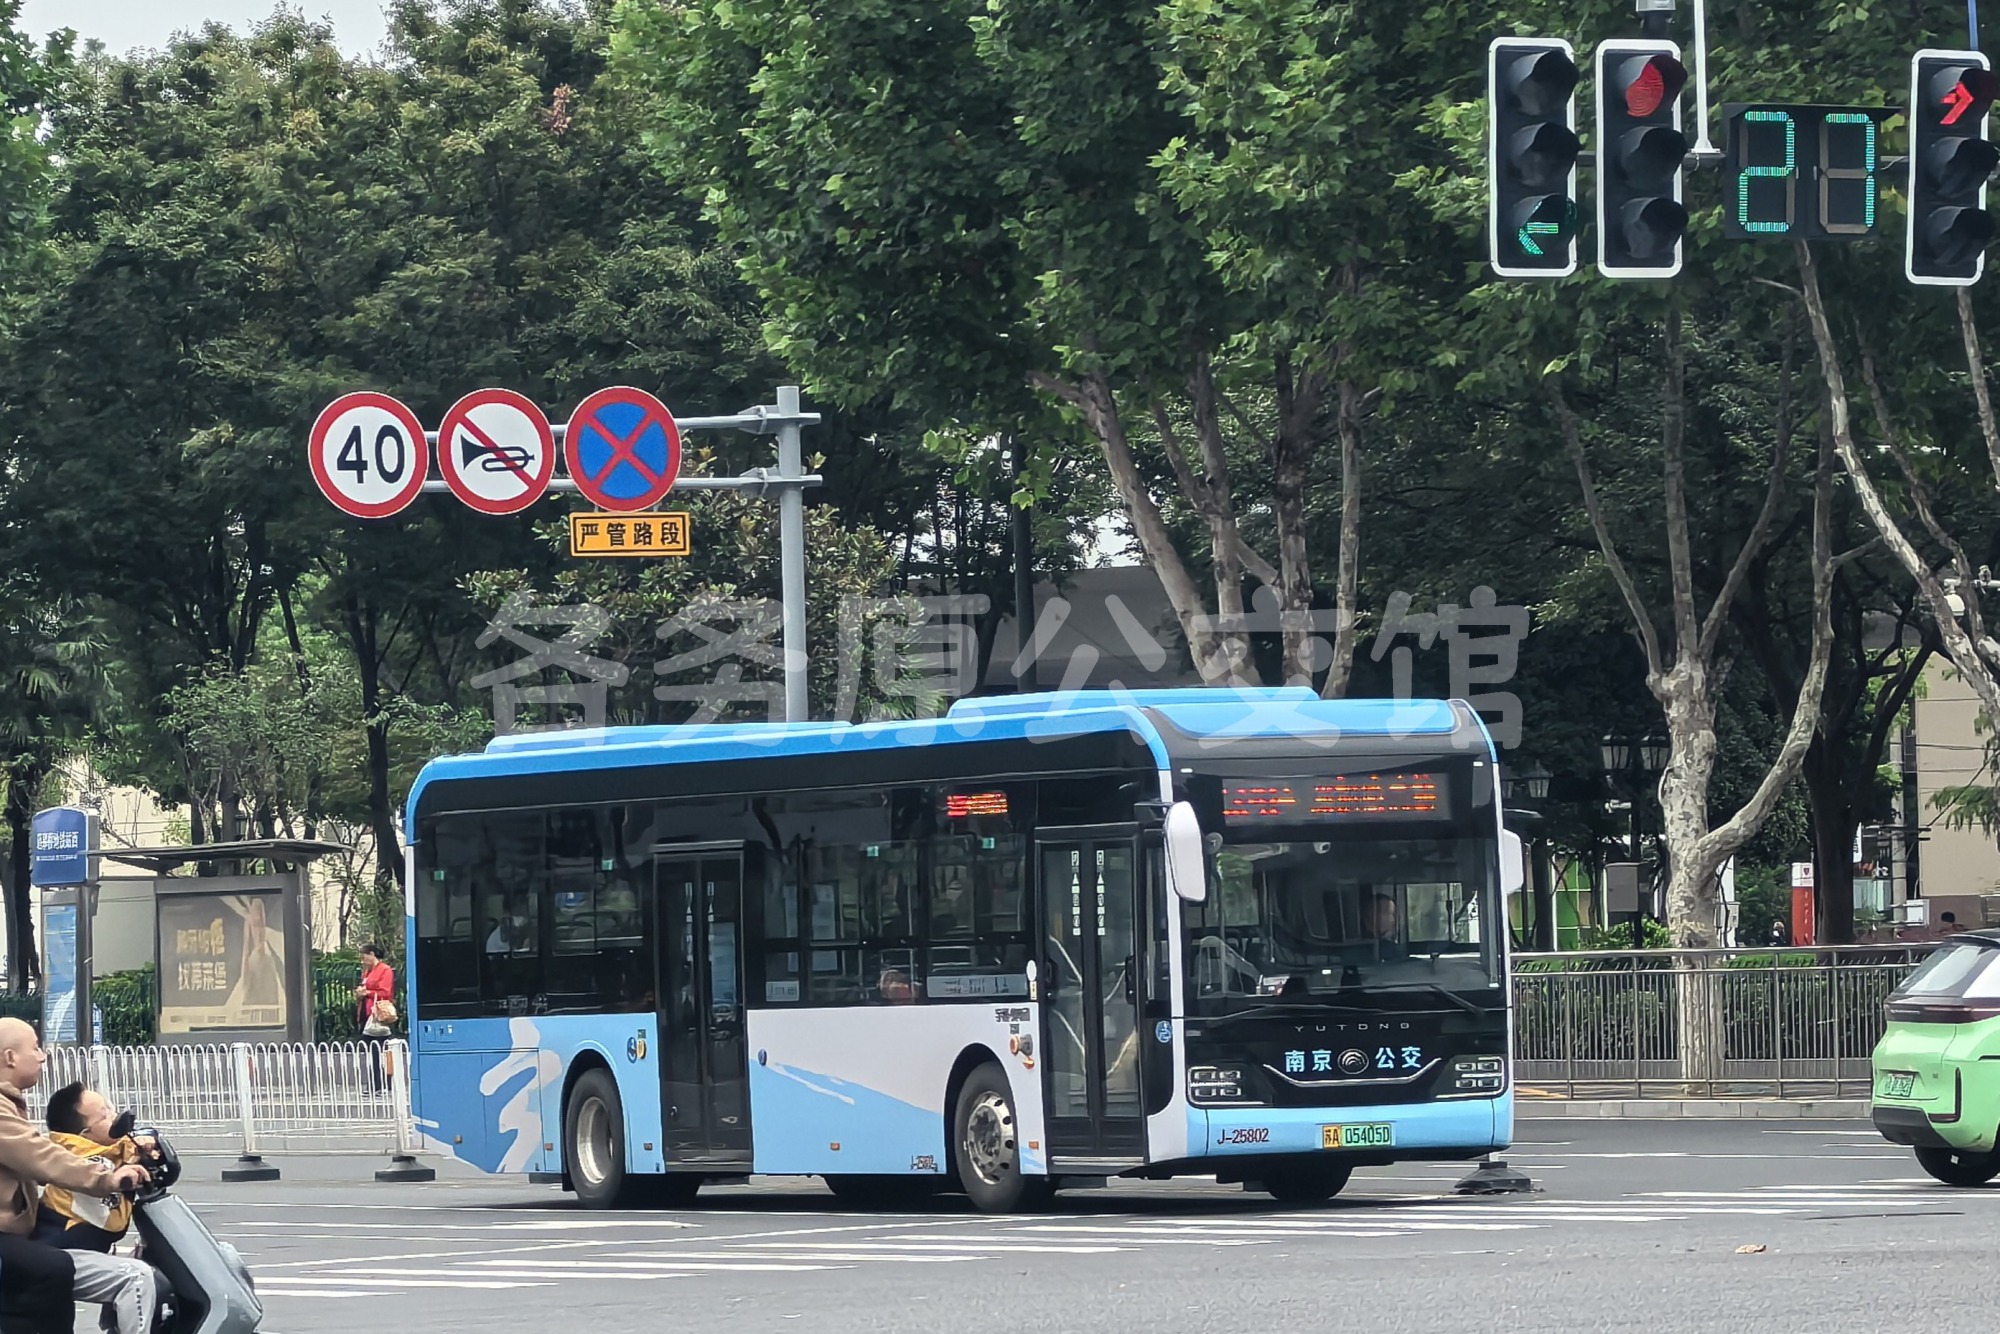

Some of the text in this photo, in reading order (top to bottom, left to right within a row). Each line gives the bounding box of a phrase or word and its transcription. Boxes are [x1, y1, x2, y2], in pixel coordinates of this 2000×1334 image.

[1738, 110, 1876, 233] 27
[336, 424, 406, 484] 40
[579, 519, 683, 548] 严管路段
[1294, 1022, 1411, 1033] YUTONG
[1284, 1045, 1423, 1073] 南京 公交
[1217, 1127, 1270, 1146] J-25802
